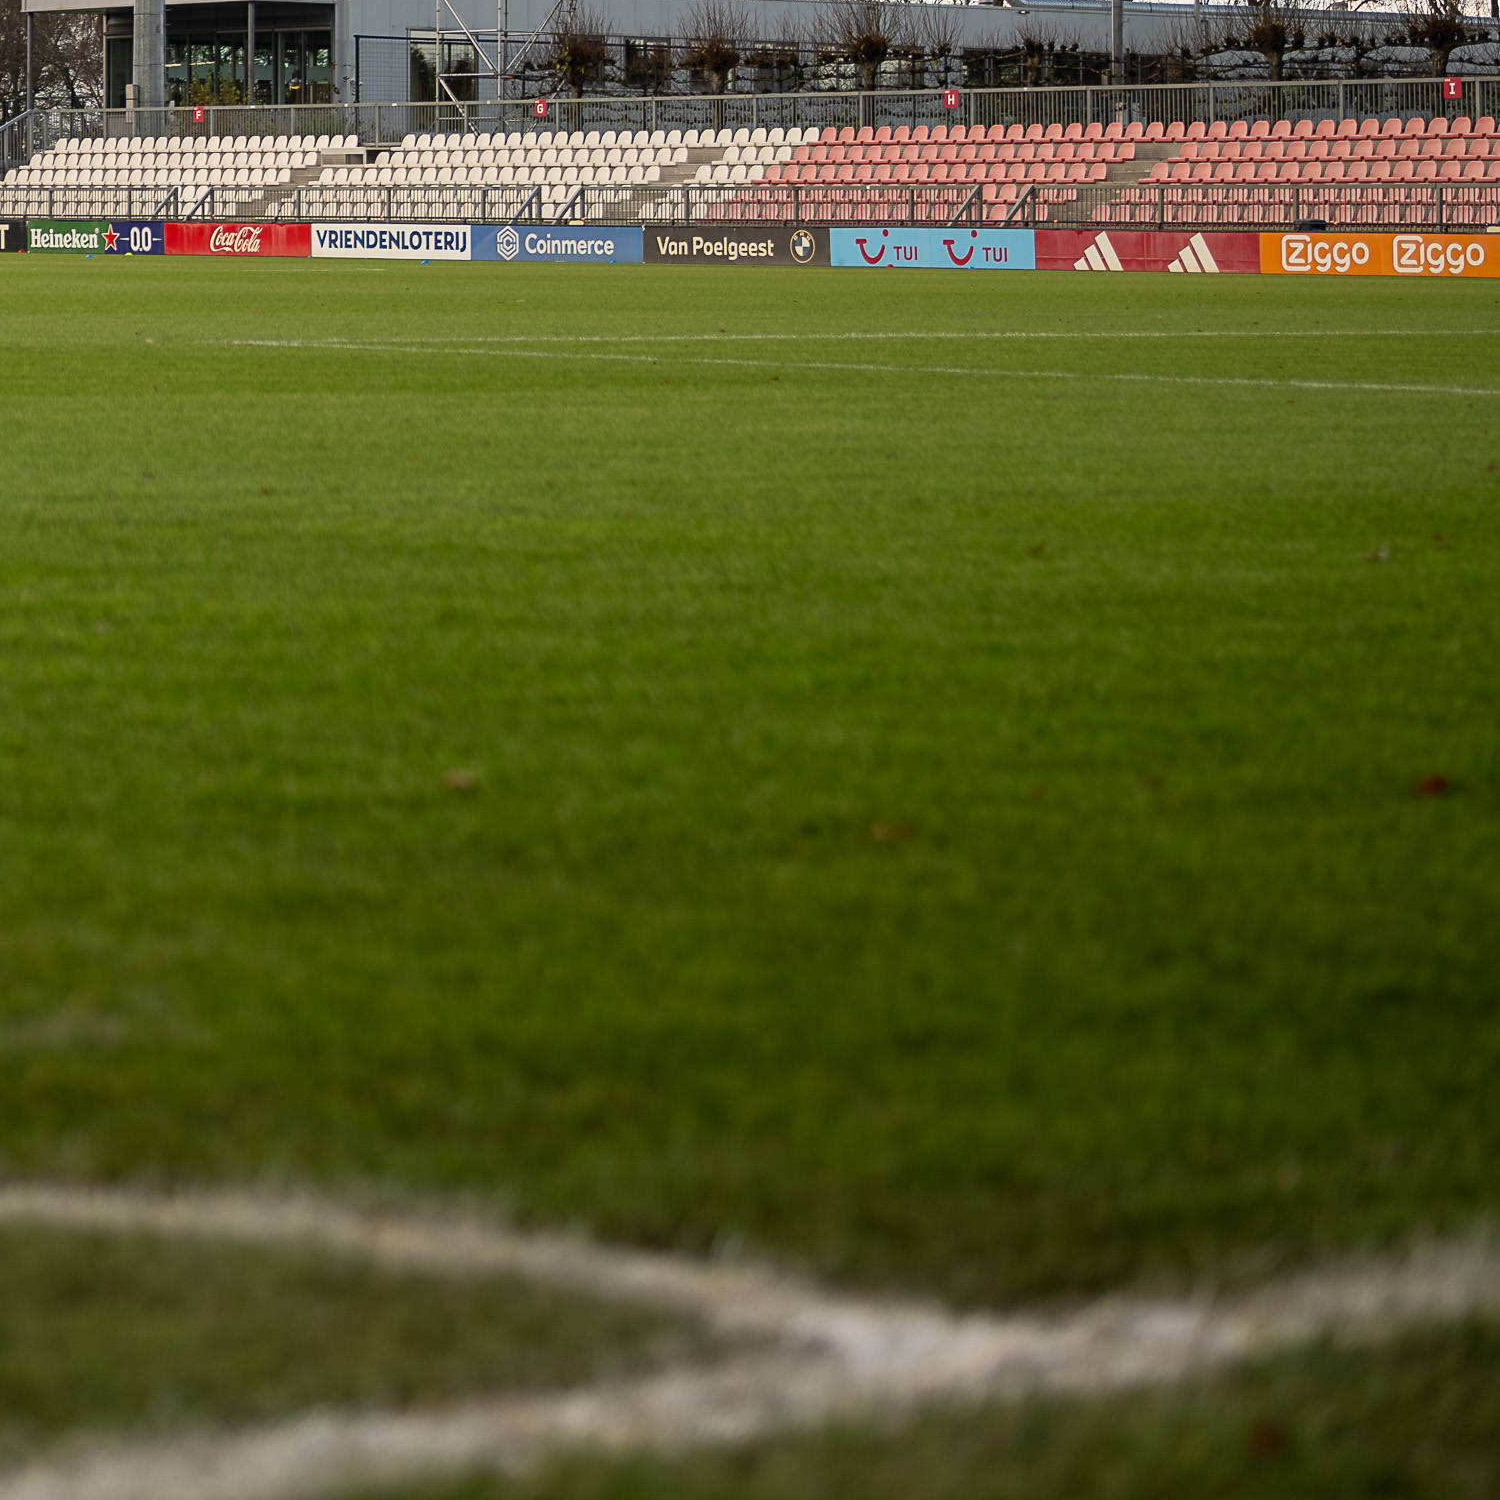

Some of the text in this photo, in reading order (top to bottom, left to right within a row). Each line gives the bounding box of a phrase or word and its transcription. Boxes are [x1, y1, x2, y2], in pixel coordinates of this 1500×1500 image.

[1450, 83, 1456, 95] I
[948, 95, 955, 105] H
[195, 110, 202, 119] F
[537, 104, 544, 114] G
[30, 227, 99, 249] Heineken
[130, 226, 152, 252] 0.0
[316, 229, 467, 252] VRIENDENLOTERIJ
[525, 233, 615, 256] Coinmerce
[656, 236, 775, 261] Van Poelgeest
[893, 245, 918, 261] TUI
[982, 246, 1008, 262] TUI
